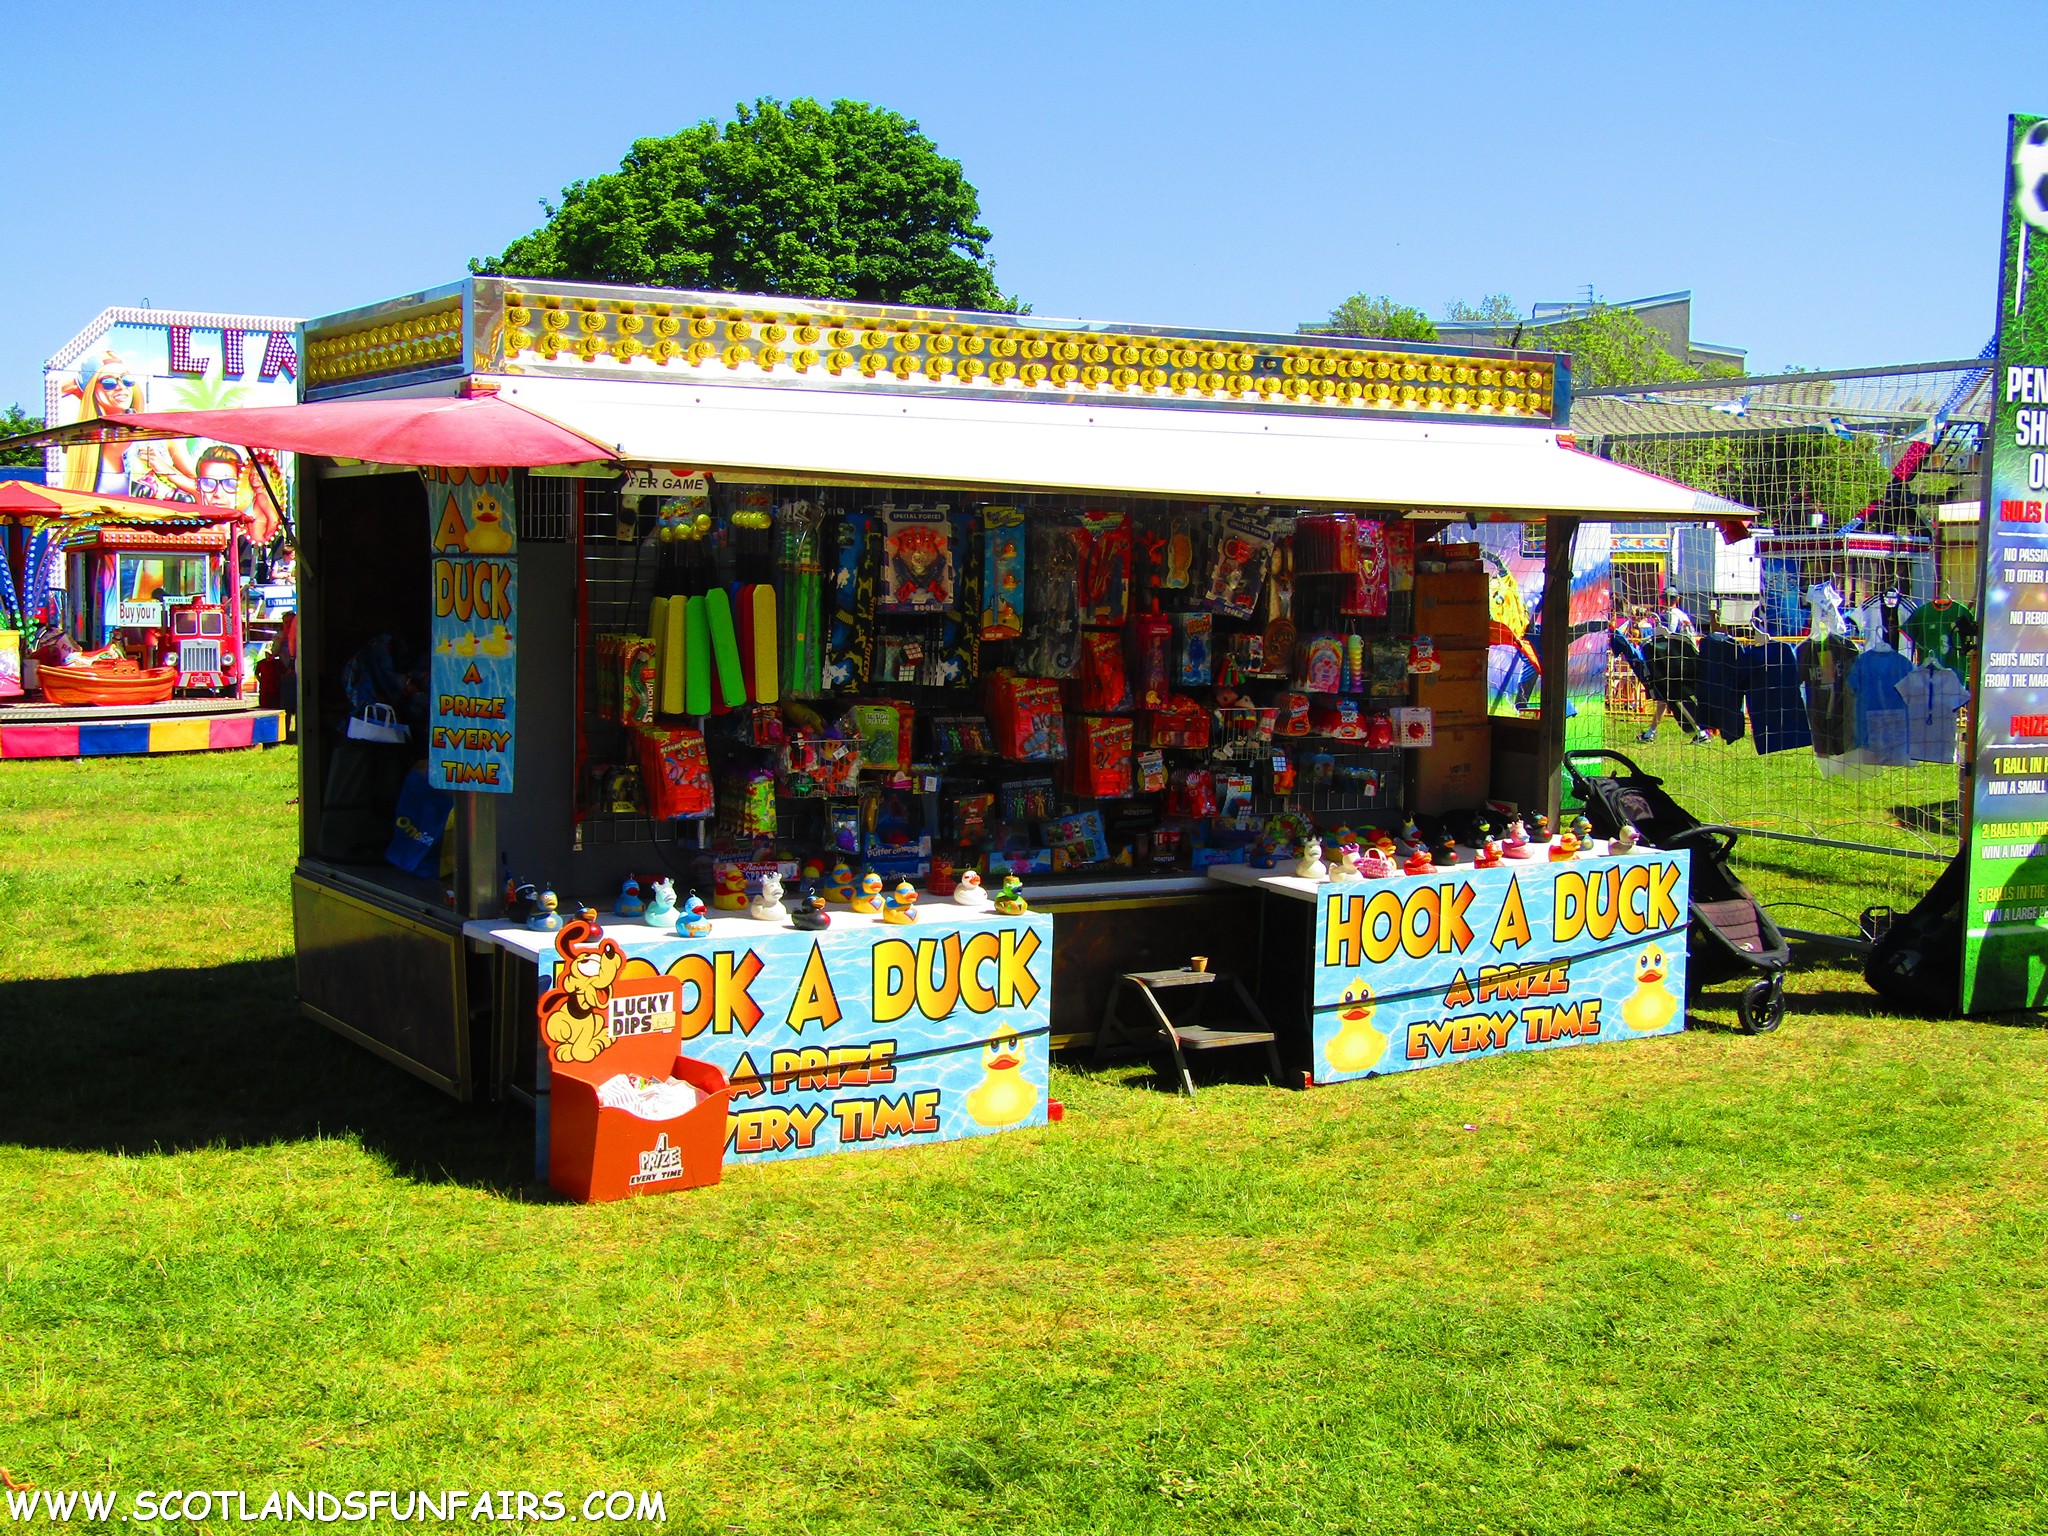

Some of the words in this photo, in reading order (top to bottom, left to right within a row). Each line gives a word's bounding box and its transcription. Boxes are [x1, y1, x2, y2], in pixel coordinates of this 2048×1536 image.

[2006, 366, 2048, 403] PEN
[2015, 409, 2048, 446] SH
[2029, 453, 2048, 491] O
[662, 478, 704, 490] GAME
[433, 490, 469, 553] A
[2000, 499, 2042, 523] RULES
[2003, 547, 2017, 562] NO
[2004, 569, 2015, 583] TO
[2017, 569, 2044, 584] OTHER
[435, 559, 512, 622] DUCK
[119, 603, 134, 619] Buy
[2009, 611, 2023, 625] NO
[2024, 611, 2048, 625] REBO
[1990, 653, 2017, 667] SHOTS
[2019, 653, 2044, 667] MUST
[462, 662, 483, 685] A
[1984, 673, 2010, 688] FROM
[2011, 674, 2028, 688] THE
[439, 694, 506, 719] PRIZE
[642, 682, 654, 723] STRETCHY
[432, 726, 512, 753] EVERY
[441, 761, 500, 784] TIME
[1993, 757, 2000, 774] 1
[2003, 757, 2028, 774] BALL
[2030, 757, 2043, 773] IN
[1988, 781, 2008, 795] WIN
[2009, 781, 2016, 794] A
[2017, 780, 2046, 794] SMALL
[1982, 824, 1989, 839] 2
[1990, 823, 2018, 838] BALLS
[2020, 822, 2031, 837] IN
[1981, 845, 2000, 859] WIN
[2002, 845, 2008, 858] A
[2010, 843, 2046, 858] MEDIUM
[1978, 888, 1985, 903] 3
[1987, 886, 2014, 902] BALLS
[2016, 885, 2027, 900] IN
[2030, 885, 2045, 899] THE
[1324, 880, 1476, 967] HOOK
[1490, 871, 1531, 951] A
[1553, 860, 1681, 942] DUCK
[1983, 908, 2002, 923] WIN
[2003, 908, 2010, 921] A
[2012, 906, 2037, 920] LARGE
[786, 937, 843, 1035] A
[872, 926, 1042, 1022] DUCK
[1443, 967, 1474, 1009] A
[1478, 957, 1571, 1003] PRIZE
[613, 994, 669, 1017] LUCKY
[613, 1014, 652, 1036] DIPS
[1405, 1010, 1517, 1060] EVERY
[1521, 999, 1602, 1045] TIME
[729, 1051, 767, 1101] A
[771, 1039, 897, 1094] PRIZE
[832, 1088, 941, 1143] TIME
[656, 1133, 668, 1153] A
[640, 1149, 680, 1171] PRIZE
[630, 1174, 657, 1184] EVERY
[662, 1169, 682, 1178] TIME
